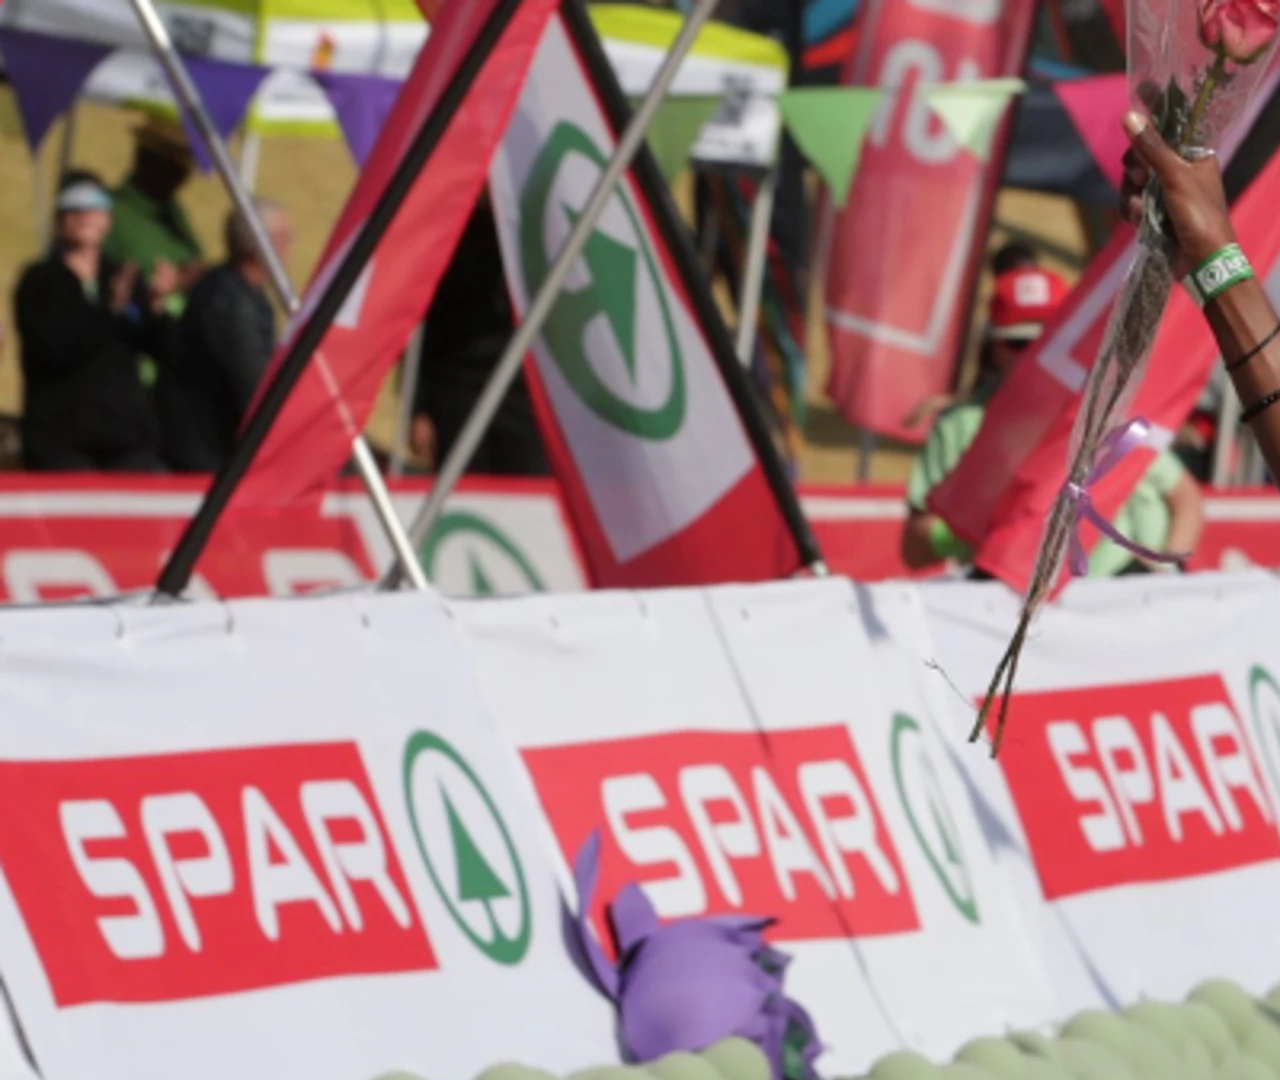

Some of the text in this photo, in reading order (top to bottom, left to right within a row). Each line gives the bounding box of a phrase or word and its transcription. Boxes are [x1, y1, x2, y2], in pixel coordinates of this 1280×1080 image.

[600, 758, 900, 919] SPAR
[1045, 702, 1276, 853] SPAR
[58, 778, 412, 961] SPAR
